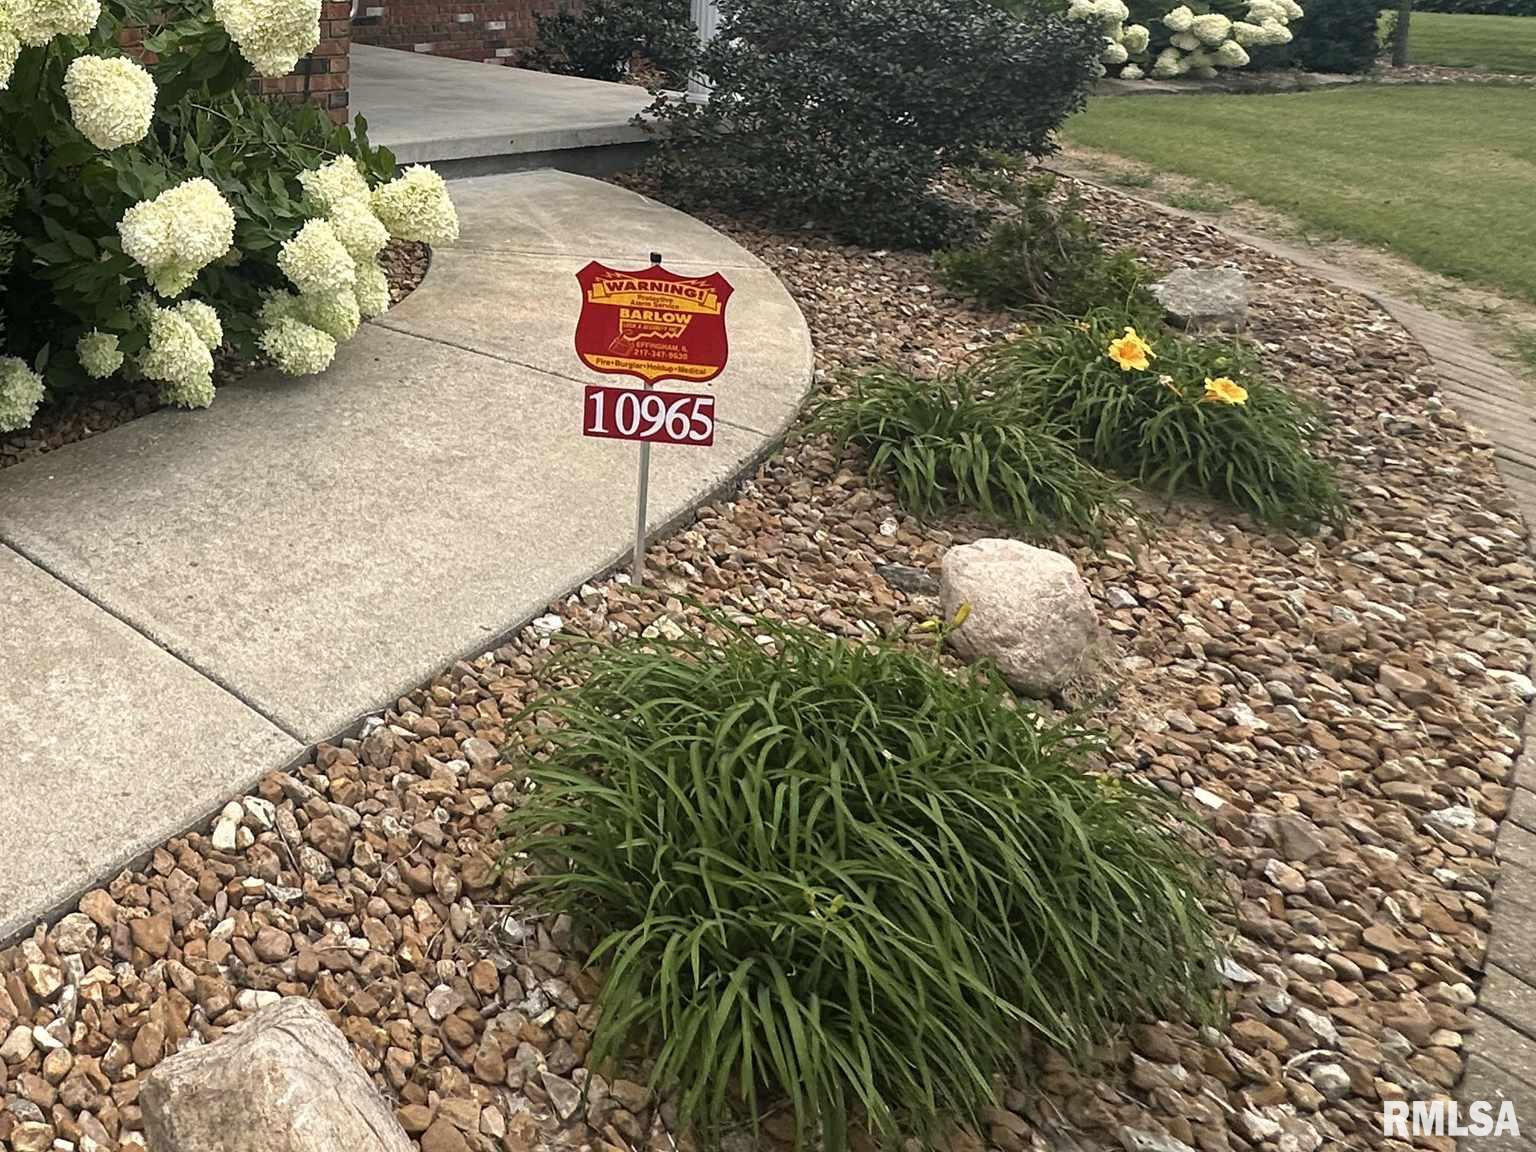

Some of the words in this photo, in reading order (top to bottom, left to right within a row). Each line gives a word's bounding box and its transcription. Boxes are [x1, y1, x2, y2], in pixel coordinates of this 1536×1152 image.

[606, 281, 704, 301] WARNING!
[620, 308, 693, 324] BARLOW
[587, 391, 714, 441] 10965
